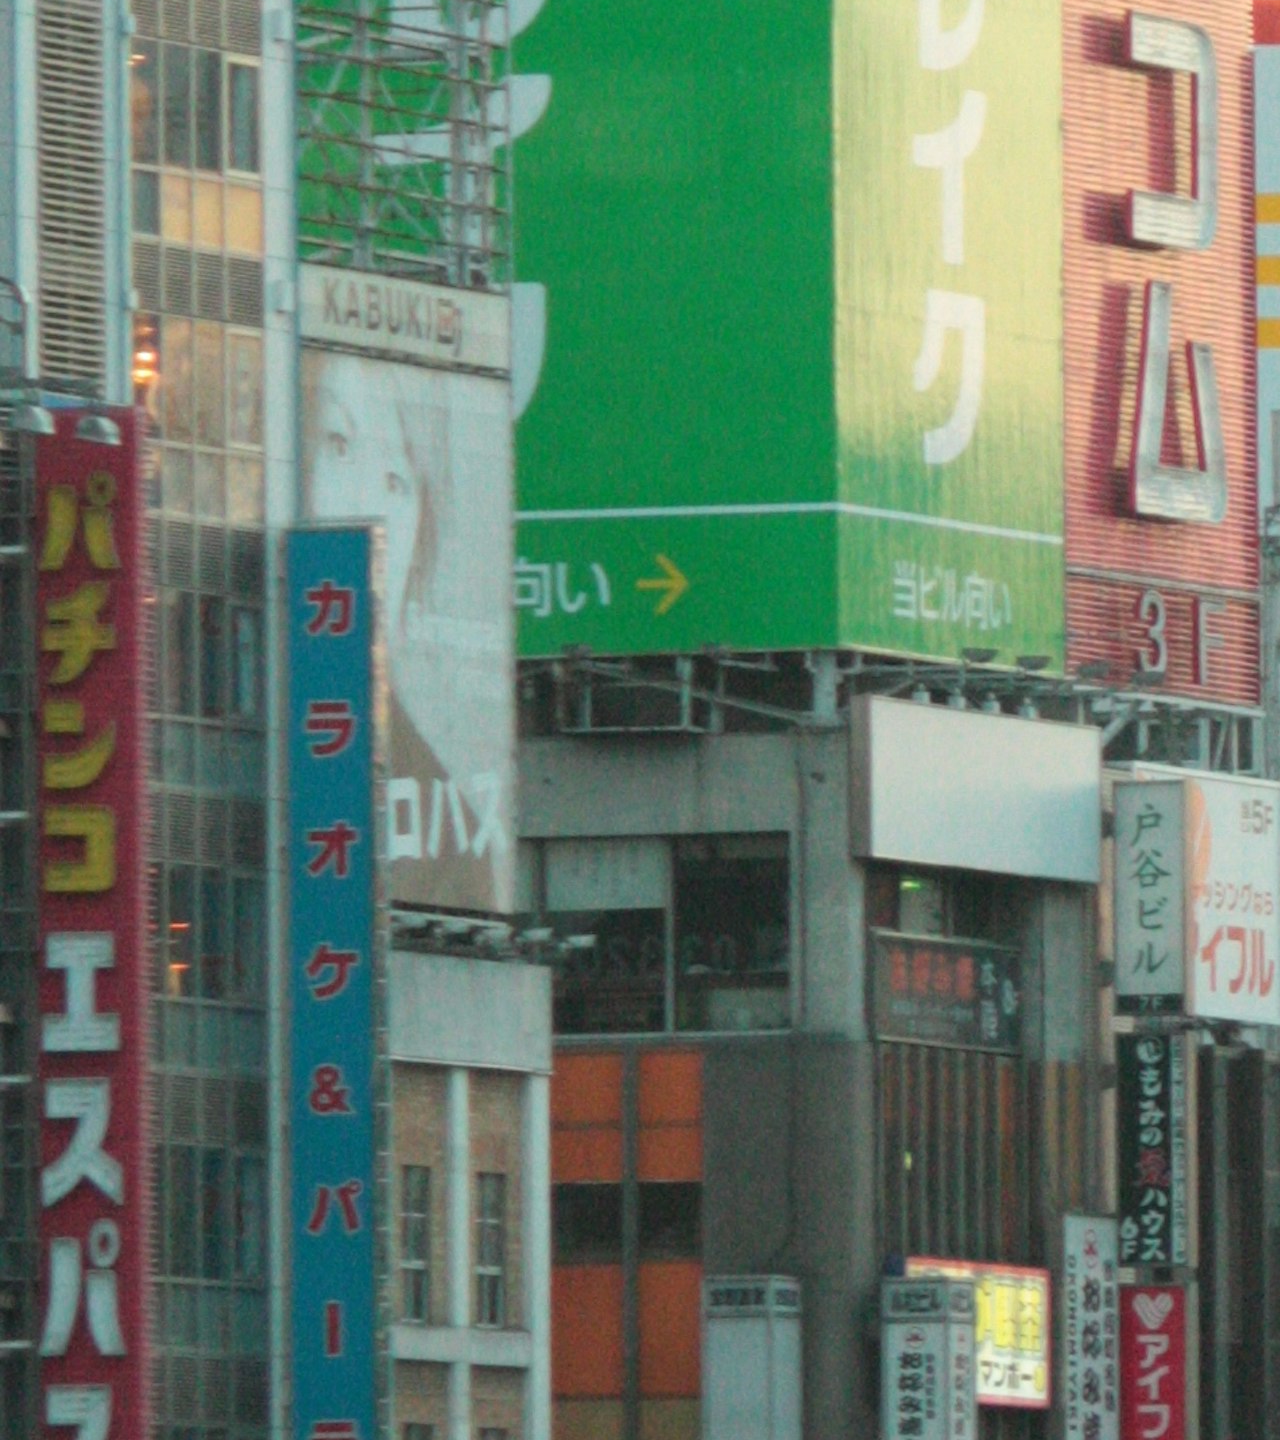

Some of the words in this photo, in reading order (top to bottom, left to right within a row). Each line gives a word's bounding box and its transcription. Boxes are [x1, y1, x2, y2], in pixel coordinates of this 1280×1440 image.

[42, 470, 120, 894] パチンコ
[1129, 803, 1172, 975] 戸谷ビル
